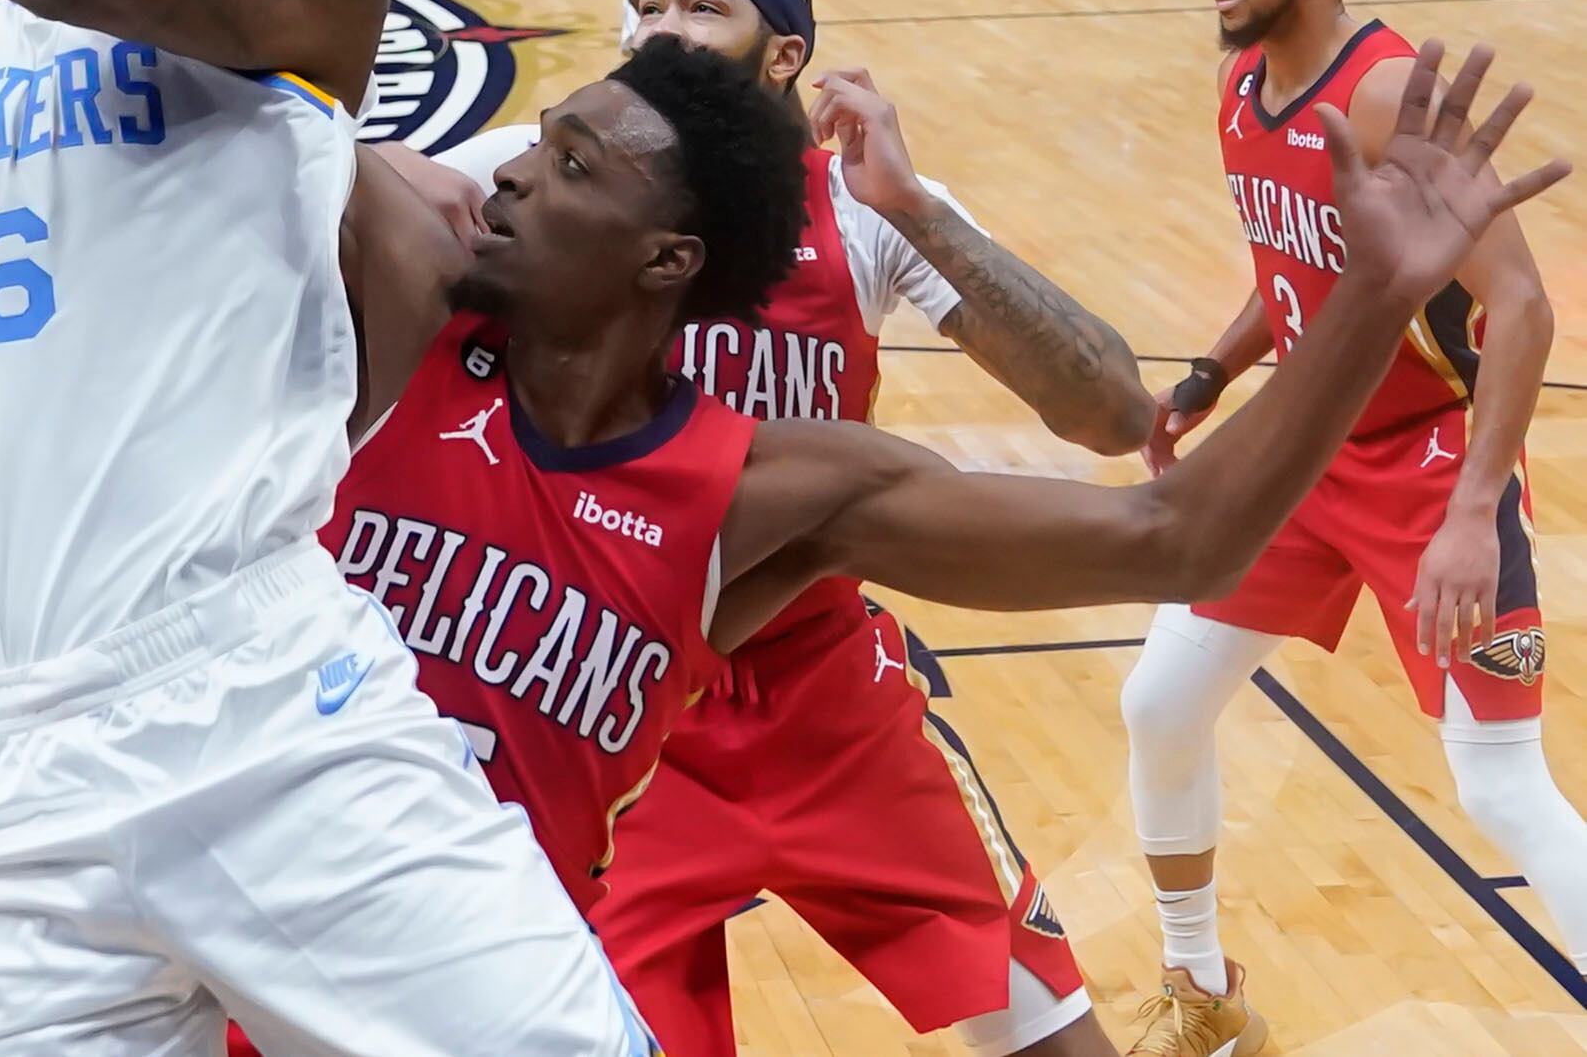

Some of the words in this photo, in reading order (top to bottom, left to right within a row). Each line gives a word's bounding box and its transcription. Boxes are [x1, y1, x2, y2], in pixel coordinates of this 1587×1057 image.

[1287, 128, 1326, 152] ibotta
[1227, 173, 1348, 275] ELICANS
[465, 345, 497, 380] 6
[680, 322, 846, 421] ICANS
[572, 491, 664, 549] ibotta
[337, 508, 672, 755] PELICANS
